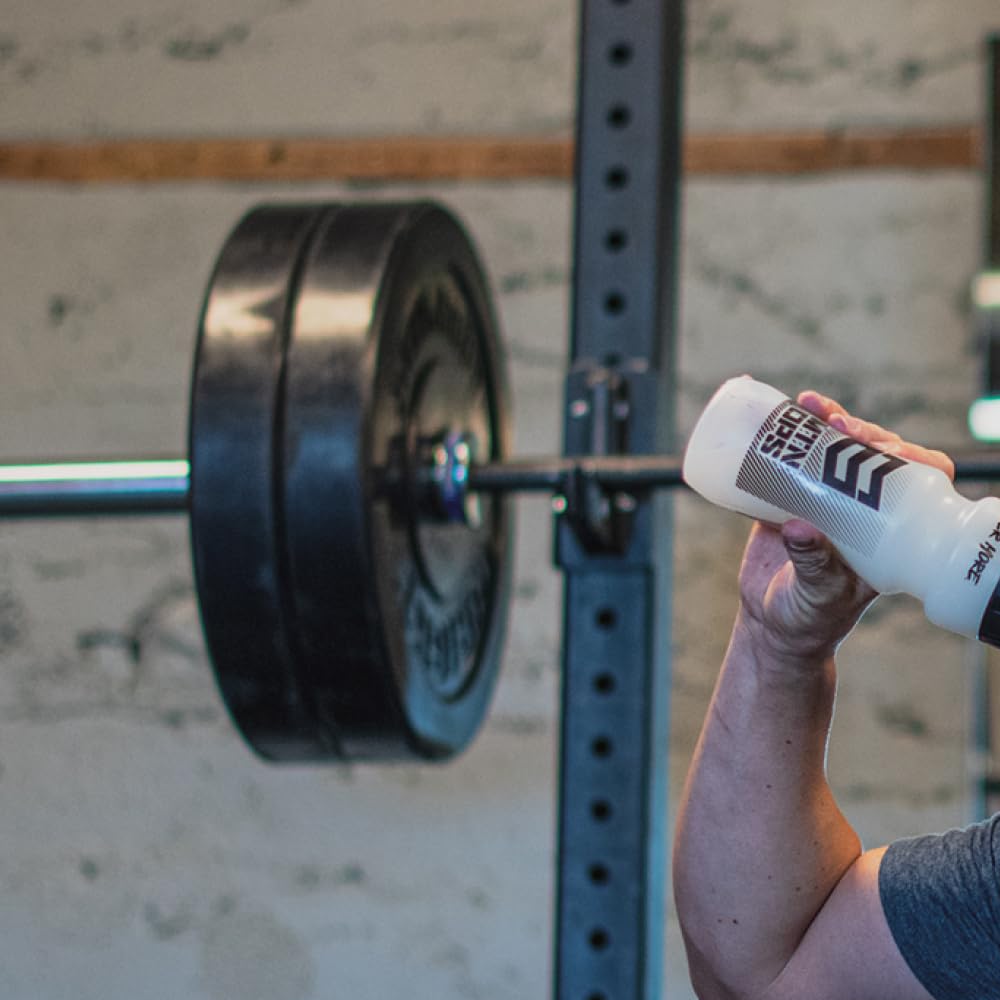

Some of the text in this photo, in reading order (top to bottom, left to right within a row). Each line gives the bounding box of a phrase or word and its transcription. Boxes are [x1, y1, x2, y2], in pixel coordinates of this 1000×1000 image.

[760, 407, 809, 458] OPS
[780, 416, 824, 469] MTN
[964, 541, 998, 586] MORE
